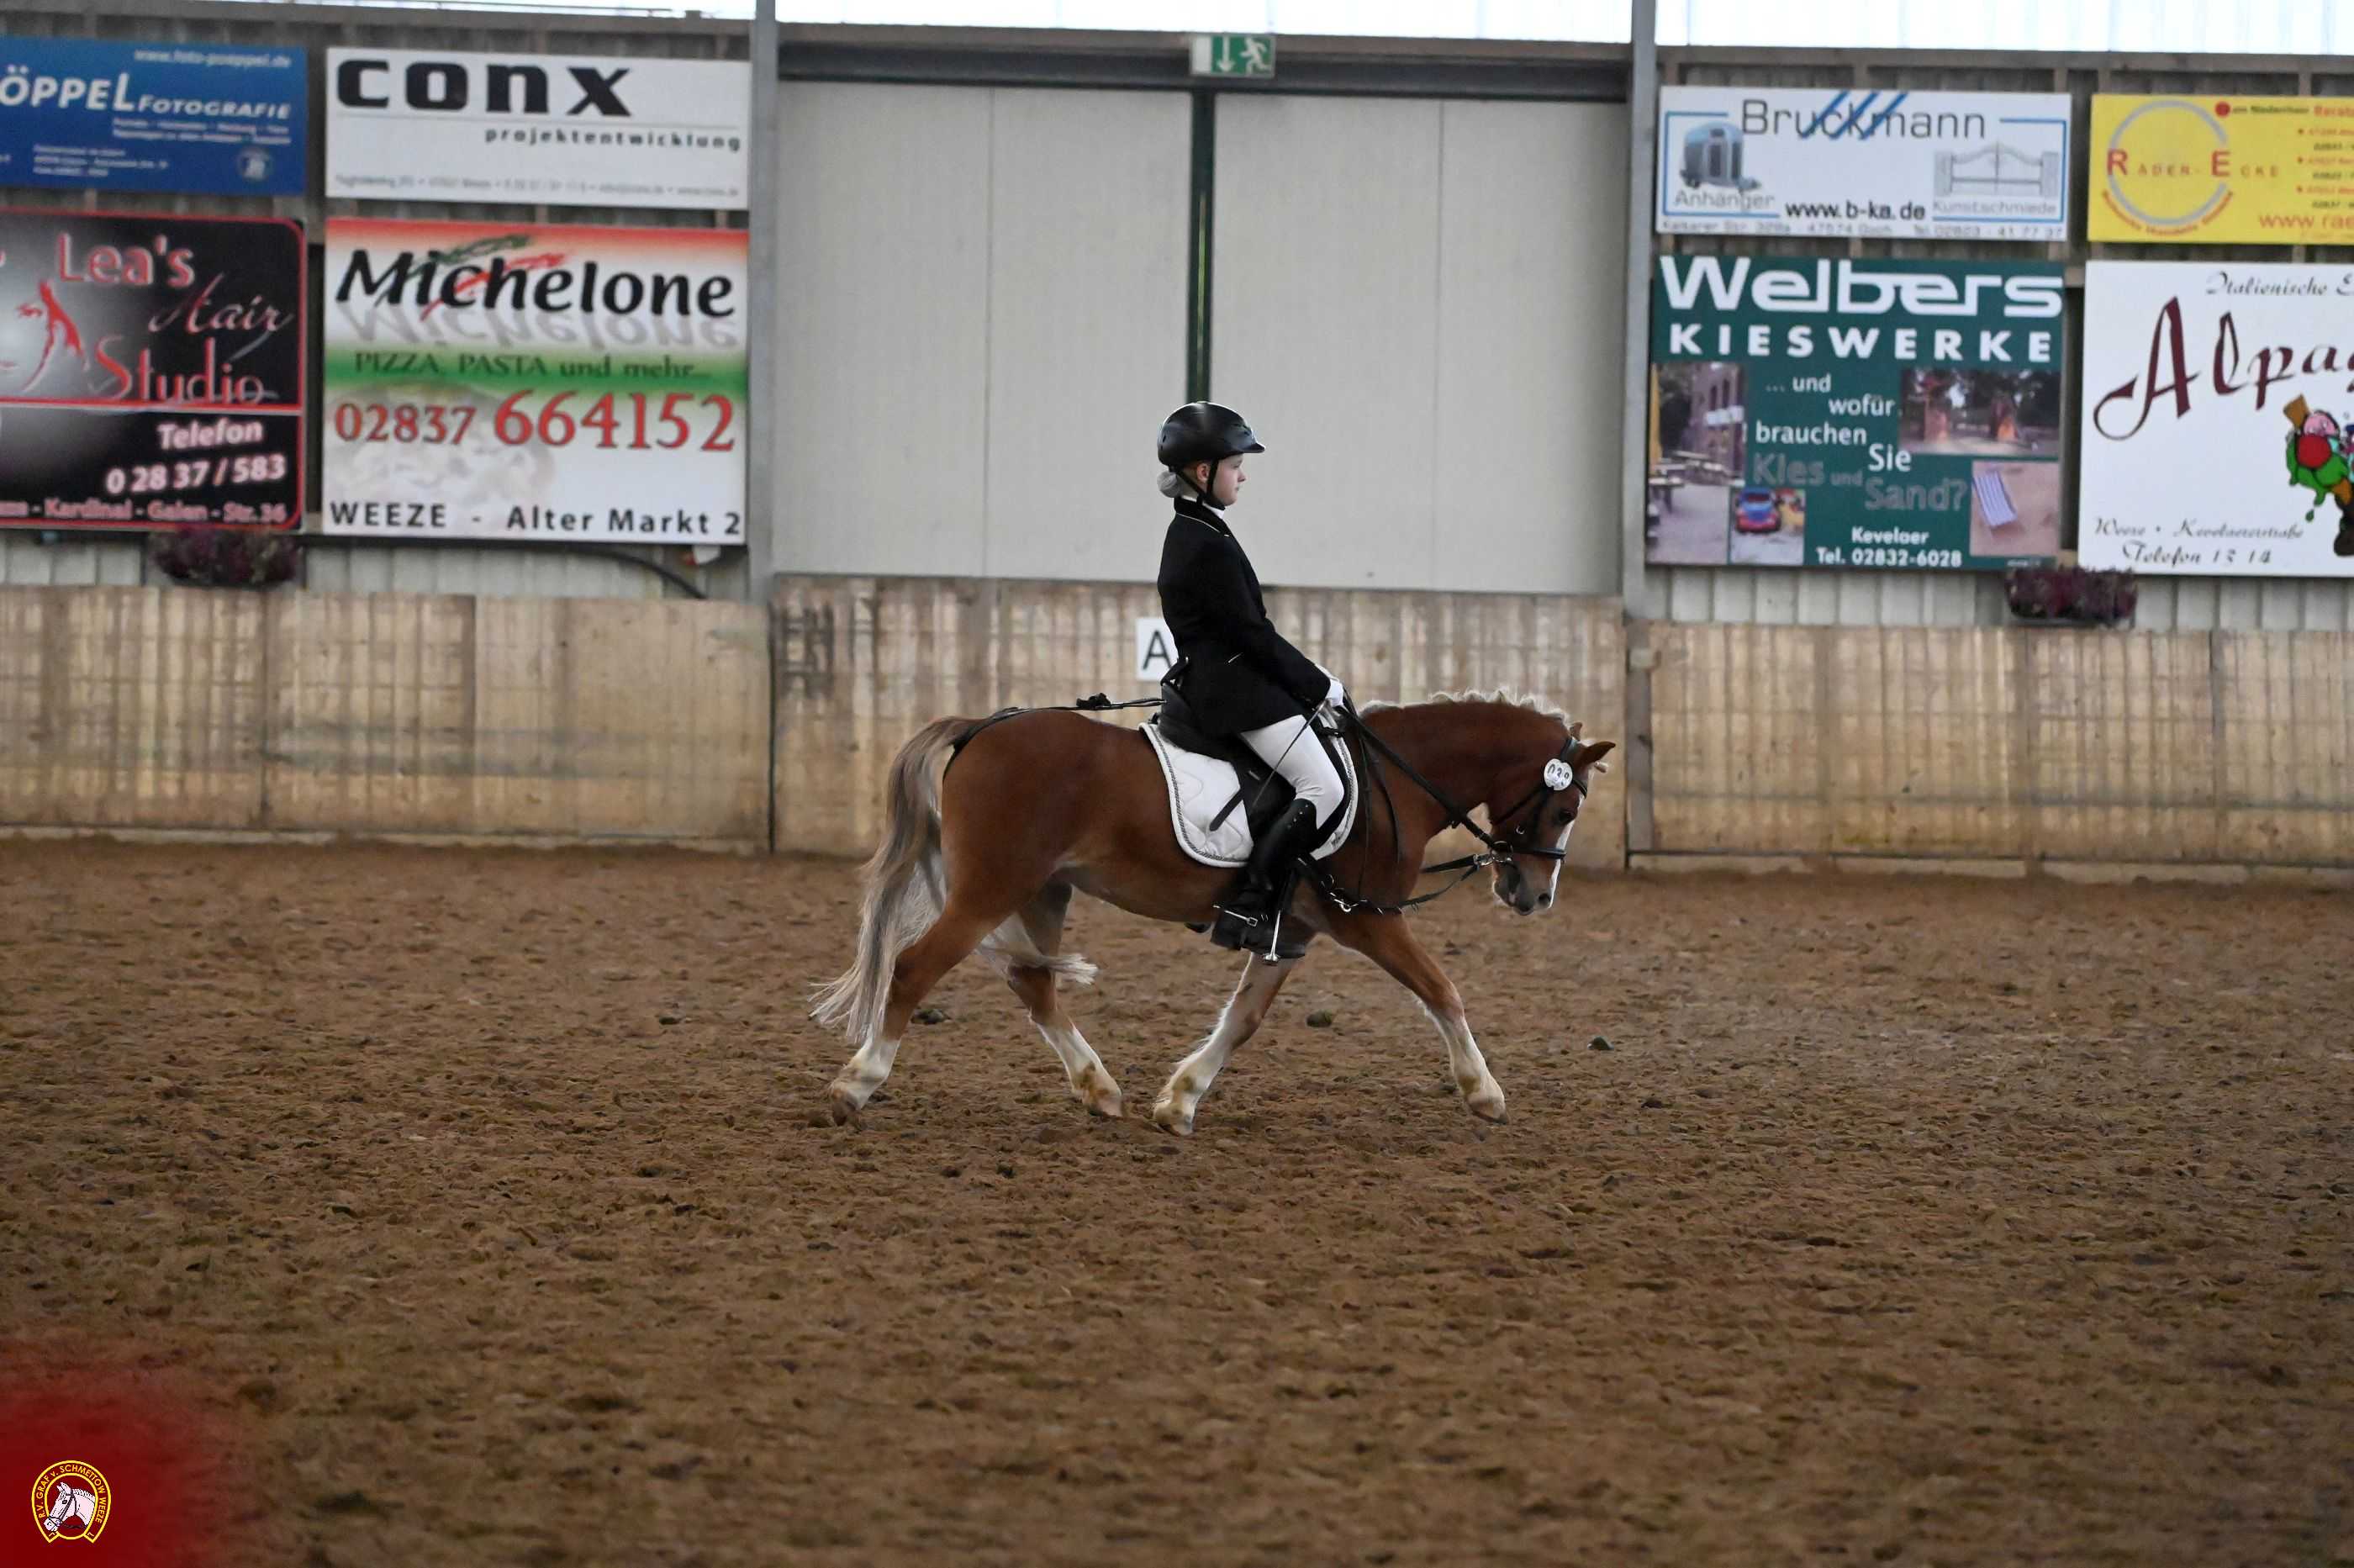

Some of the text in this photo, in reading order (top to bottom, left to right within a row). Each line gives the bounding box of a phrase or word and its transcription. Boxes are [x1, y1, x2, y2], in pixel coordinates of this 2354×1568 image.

[138, 94, 291, 119] FOTOGRAFIE
[337, 59, 632, 117] conx
[485, 126, 741, 151] projektentwicklung
[1785, 200, 1926, 221] www.b-ka.de
[58, 232, 195, 287] Lea's
[335, 247, 737, 318] Michelone
[1660, 255, 2064, 318] Welbers
[148, 272, 293, 353] Hair
[1669, 323, 2052, 362] KIESWERKE
[89, 335, 277, 404] Studio
[460, 354, 548, 377] PASTA
[559, 356, 611, 378] und
[1792, 373, 1832, 393] und
[2093, 296, 2354, 441] Alpa
[334, 389, 736, 452] 02837 664152
[1829, 393, 1896, 417] wofür
[156, 417, 263, 450] Telefon
[1755, 421, 1867, 446] brauchen
[105, 467, 126, 494] 0
[130, 462, 168, 493] 28
[172, 460, 210, 488] 37
[231, 453, 287, 483] 583
[1867, 443, 1912, 473] Sie
[1753, 453, 1825, 486] Kies
[1864, 478, 1968, 512] Sand?
[330, 501, 447, 528] WEEZE
[507, 504, 594, 532] Alter
[608, 508, 710, 536] Markt
[724, 511, 742, 536] 2
[1816, 546, 1963, 568] Tel. 02832-6028
[2123, 539, 2201, 568] Telefon
[1142, 630, 1172, 670] A
